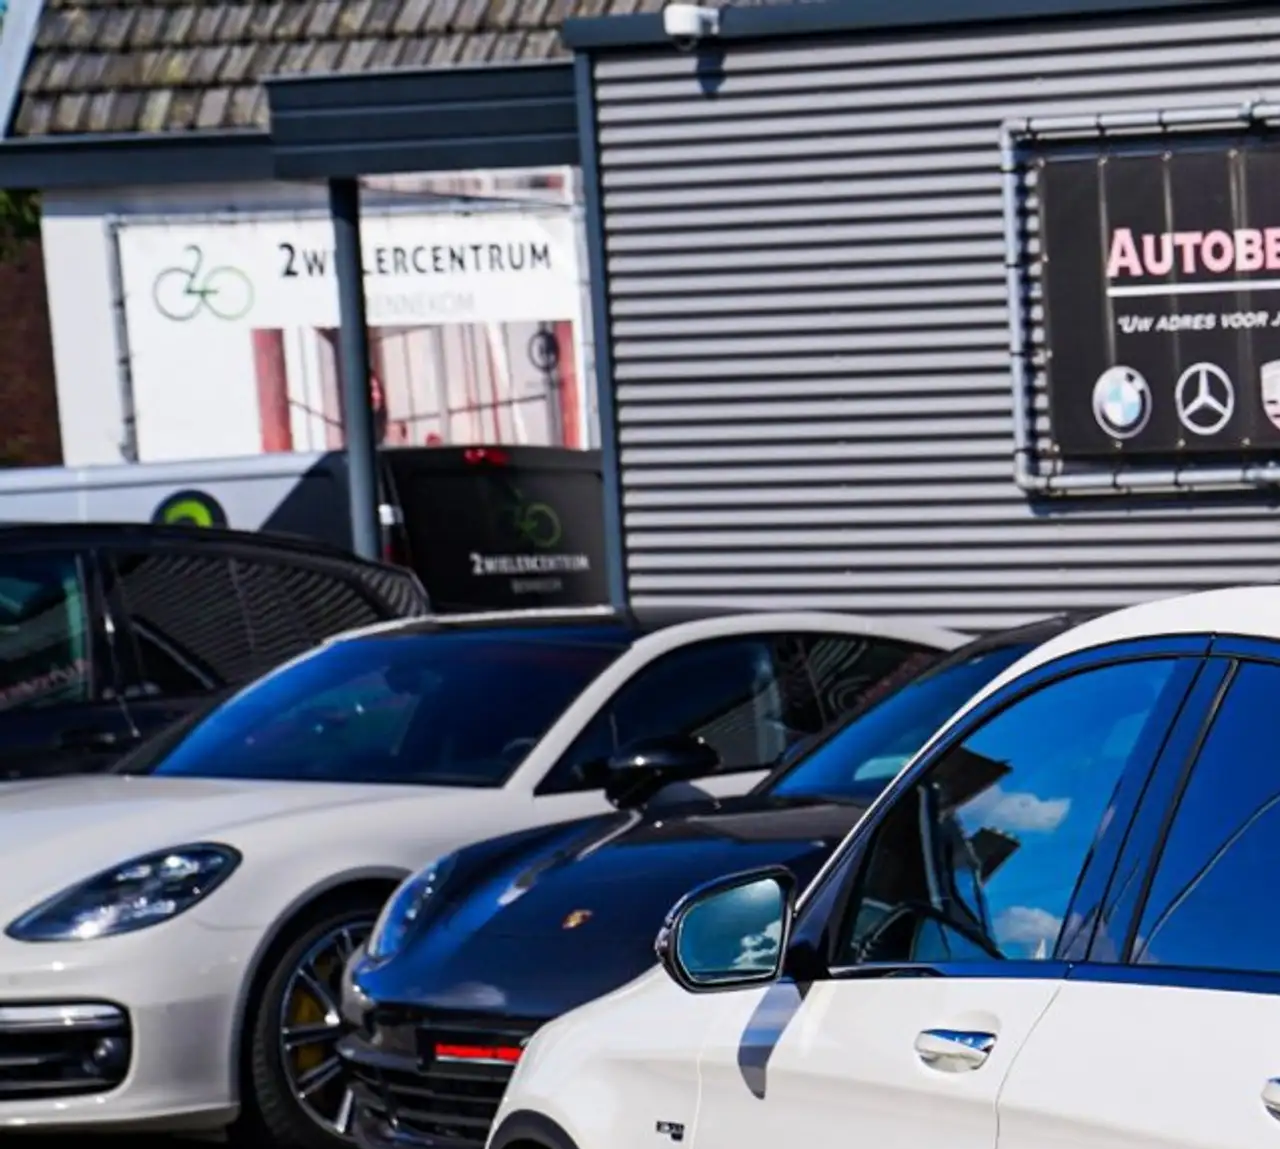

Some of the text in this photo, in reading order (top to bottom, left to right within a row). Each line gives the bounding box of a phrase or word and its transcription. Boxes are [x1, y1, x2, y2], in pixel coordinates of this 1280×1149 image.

[279, 242, 552, 277] 2WERCENTRUM
[1155, 312, 1216, 332] ADRES
[1221, 310, 1269, 329] VOOR
